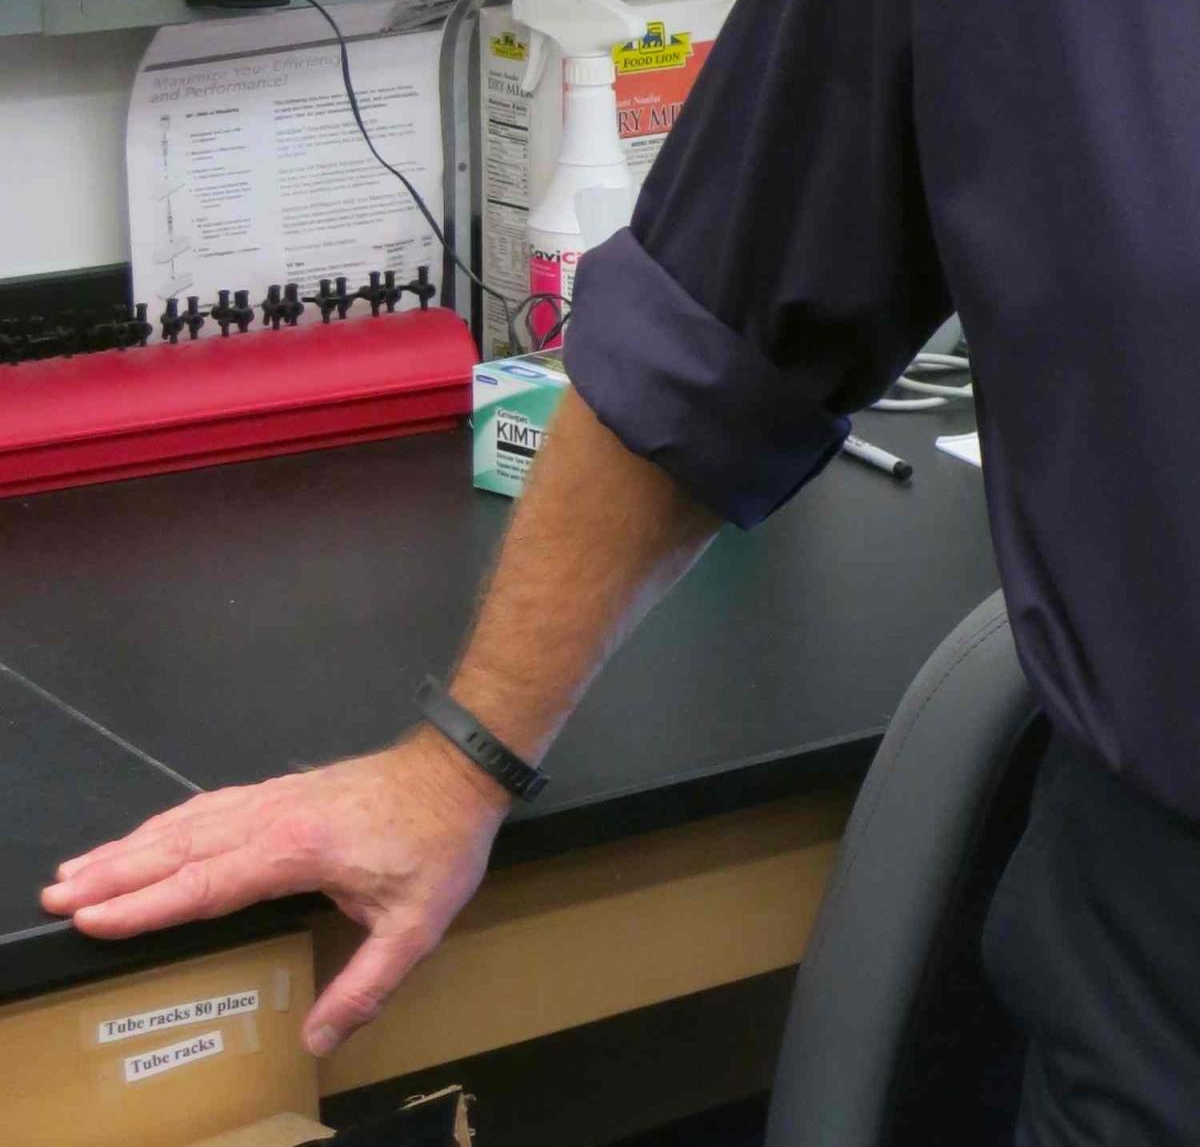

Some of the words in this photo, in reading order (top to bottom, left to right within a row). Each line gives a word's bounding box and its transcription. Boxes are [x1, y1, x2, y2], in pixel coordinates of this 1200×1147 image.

[623, 57, 653, 68] FOOD
[655, 53, 681, 64] LION
[150, 88, 181, 104] and
[617, 109, 642, 134] RY
[496, 421, 547, 447] KIMT
[104, 1019, 145, 1036] Tube
[149, 1008, 191, 1027] racks
[195, 1001, 213, 1017] 80
[217, 993, 256, 1016] place
[130, 1053, 170, 1074] Tube
[174, 1037, 216, 1061] racks
